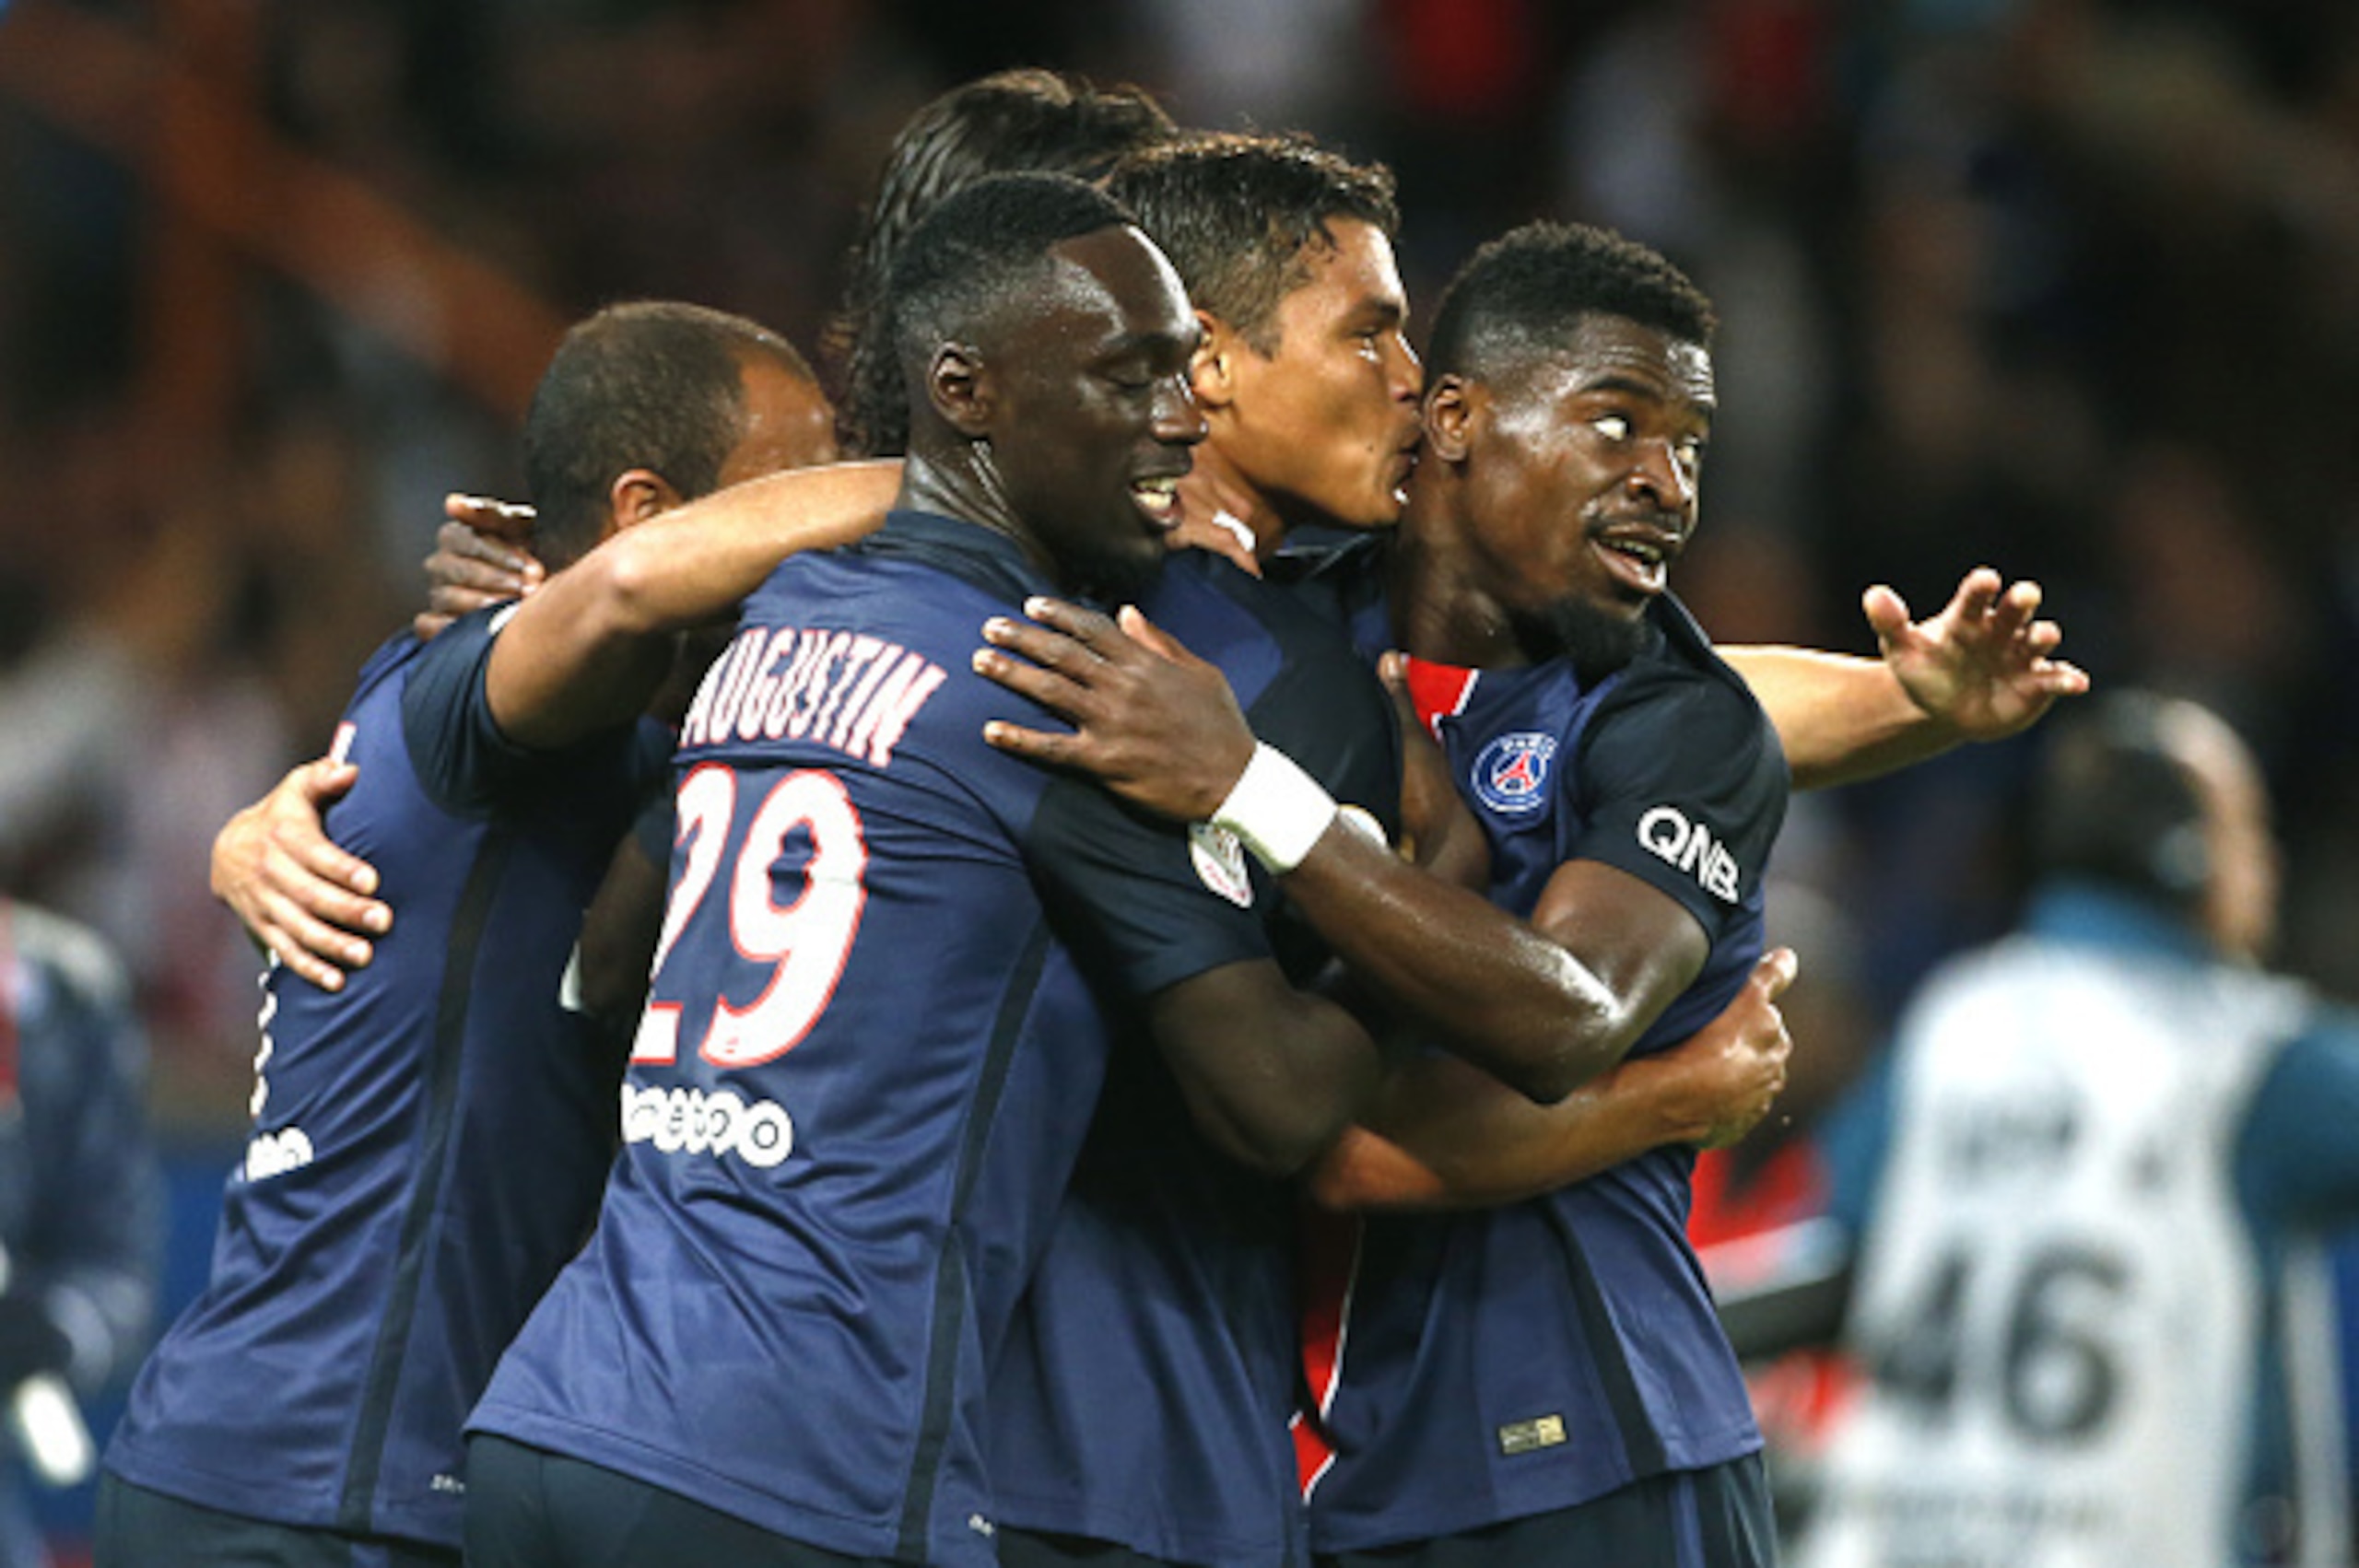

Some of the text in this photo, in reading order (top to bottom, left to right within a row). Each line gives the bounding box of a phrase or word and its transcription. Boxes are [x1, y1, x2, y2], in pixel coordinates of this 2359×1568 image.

[678, 626, 948, 767] AUGUSTIN
[628, 761, 869, 1068] 29
[1637, 806, 1739, 905] QNB
[1863, 1236, 2138, 1452] 46
